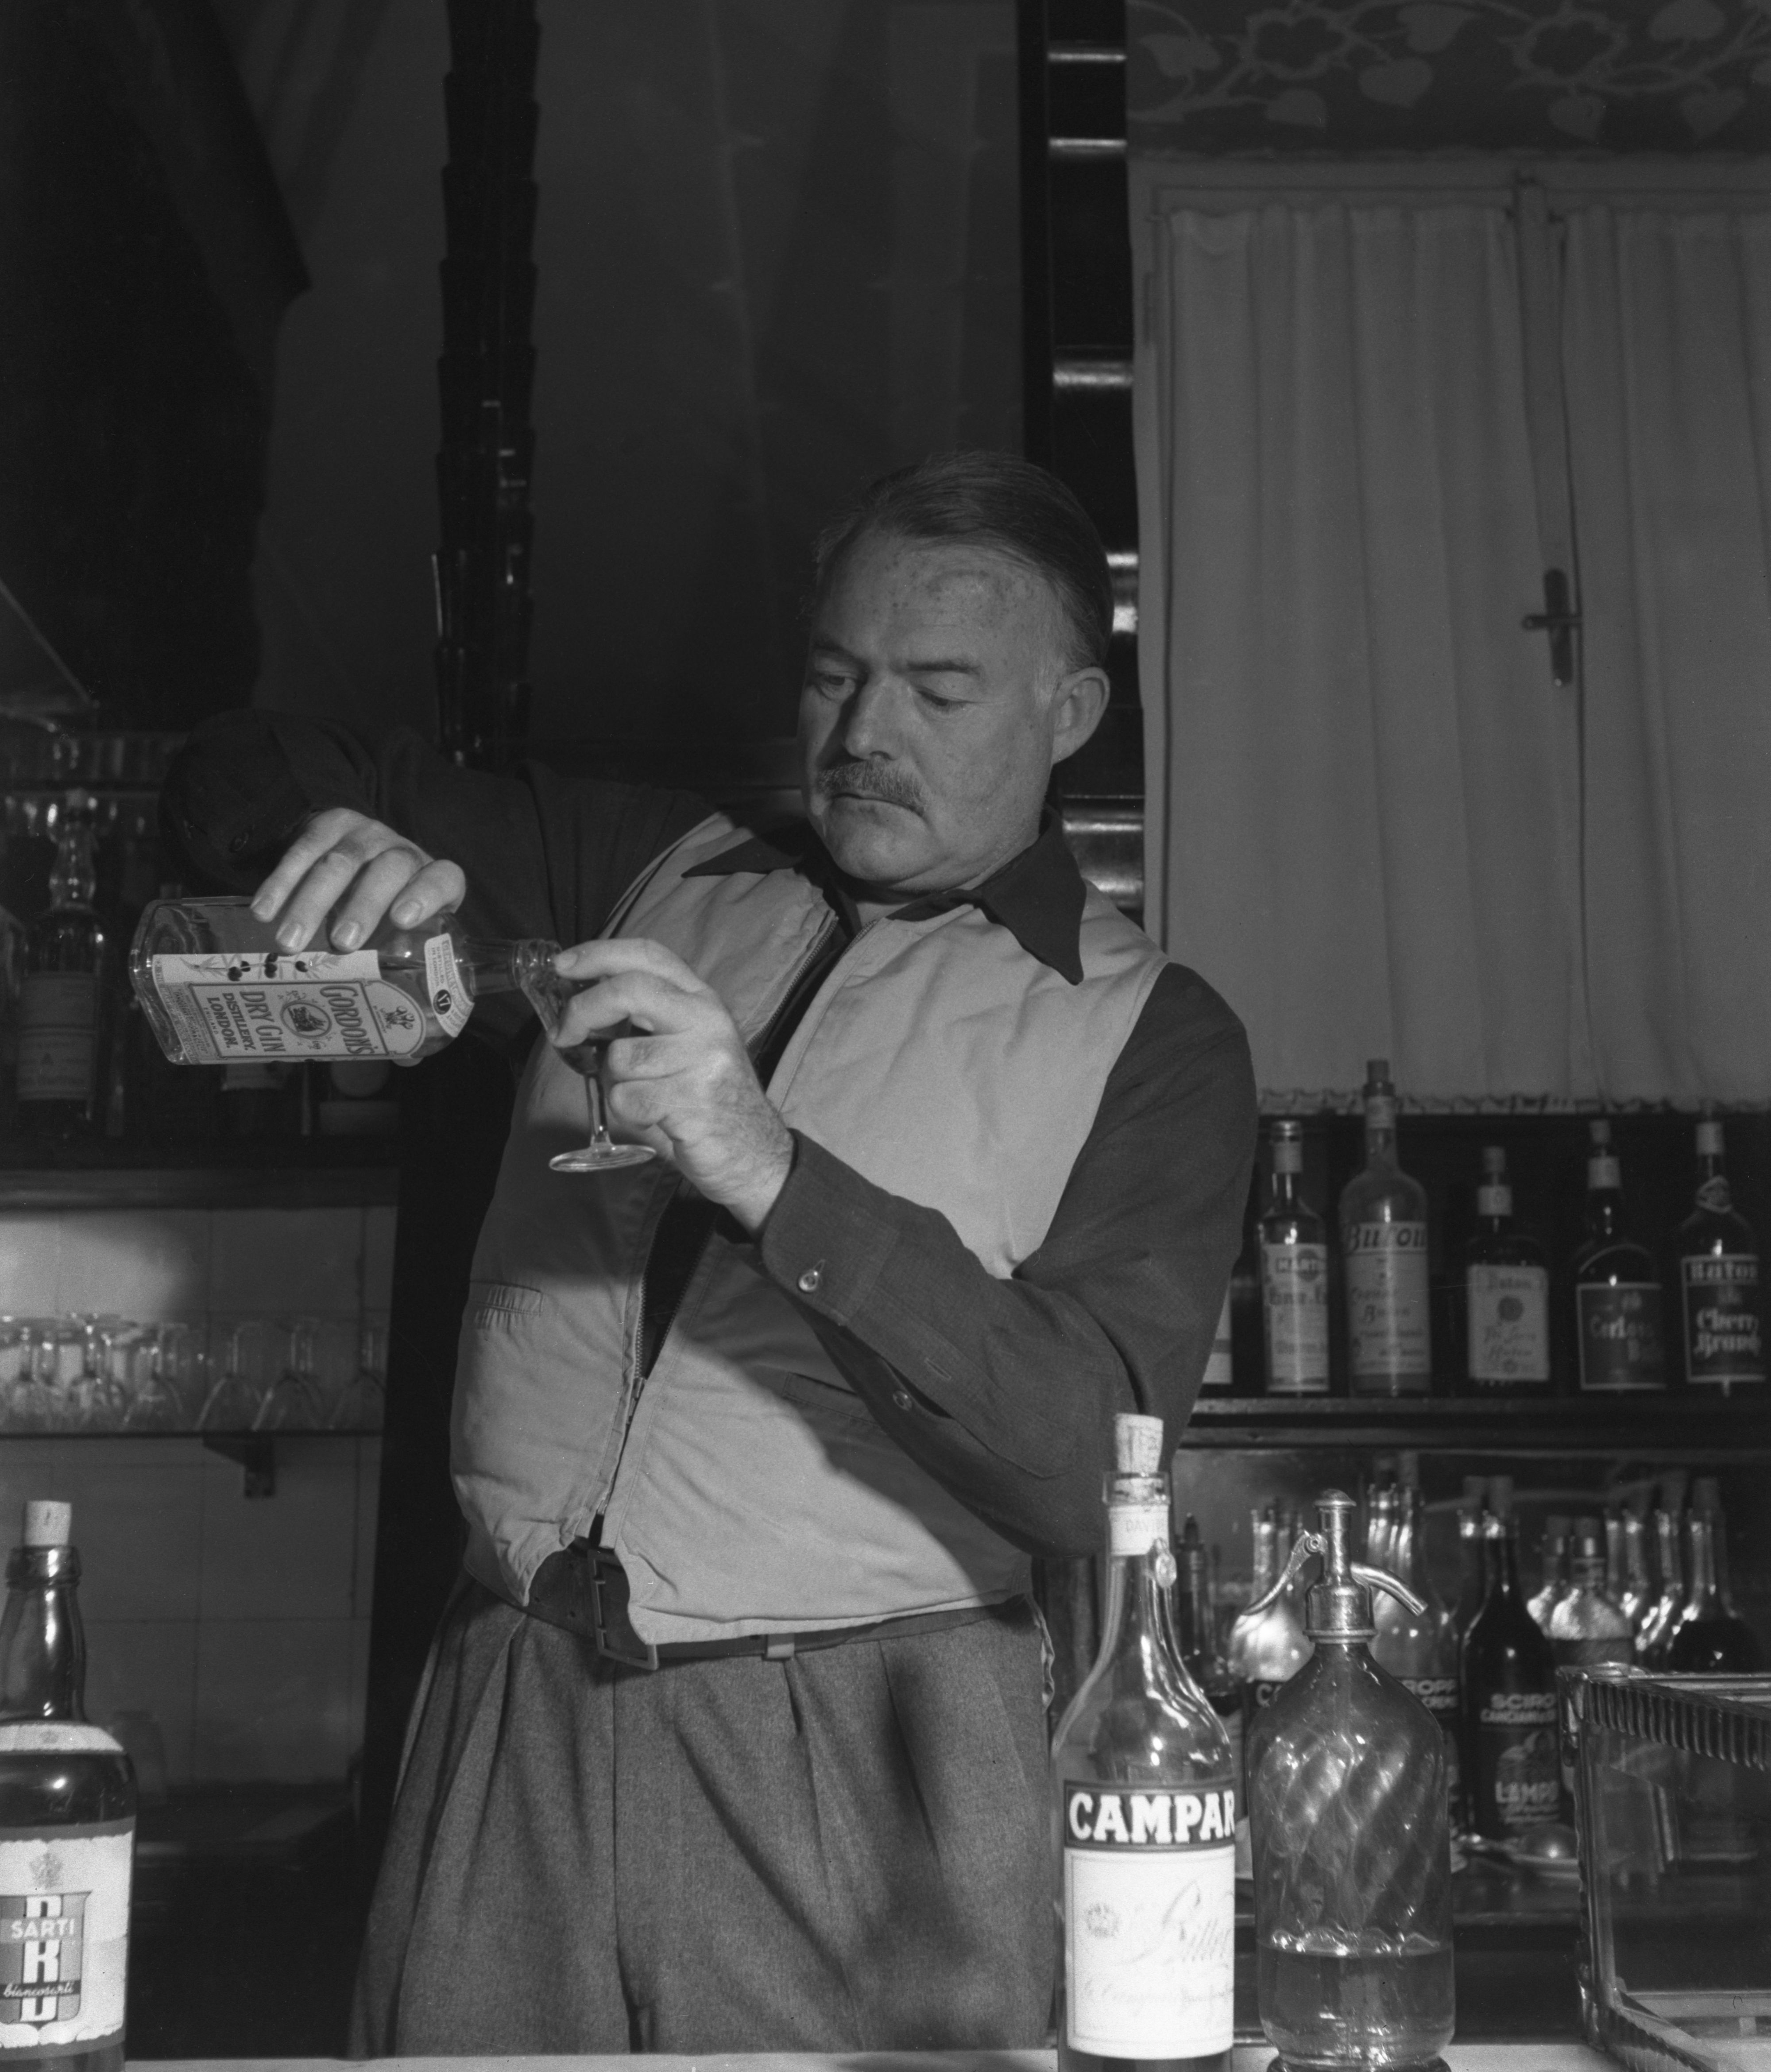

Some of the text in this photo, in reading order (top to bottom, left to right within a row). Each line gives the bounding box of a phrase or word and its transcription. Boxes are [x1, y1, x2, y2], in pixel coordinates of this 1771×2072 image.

[205, 1007, 219, 1034] ENGLAND
[207, 997, 238, 1048] LONDON.
[222, 993, 256, 1050] DISTILLERY.
[239, 991, 286, 1052] DRY GIN
[10, 1918, 74, 1940] SARTI
